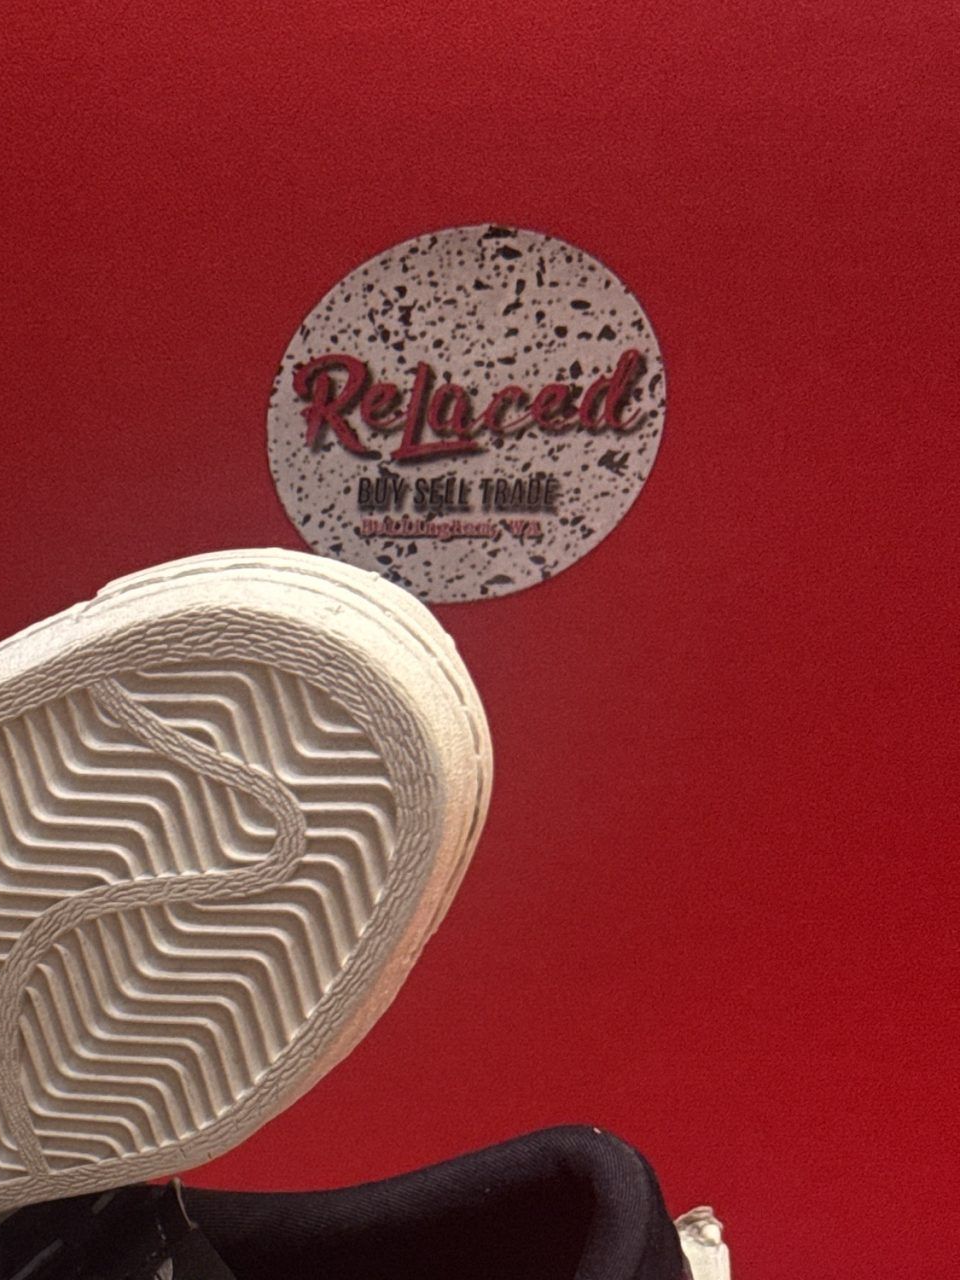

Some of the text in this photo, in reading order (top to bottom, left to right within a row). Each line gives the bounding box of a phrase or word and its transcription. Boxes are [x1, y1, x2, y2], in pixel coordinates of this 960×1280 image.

[357, 476, 558, 509] BUY SELL TRADE
